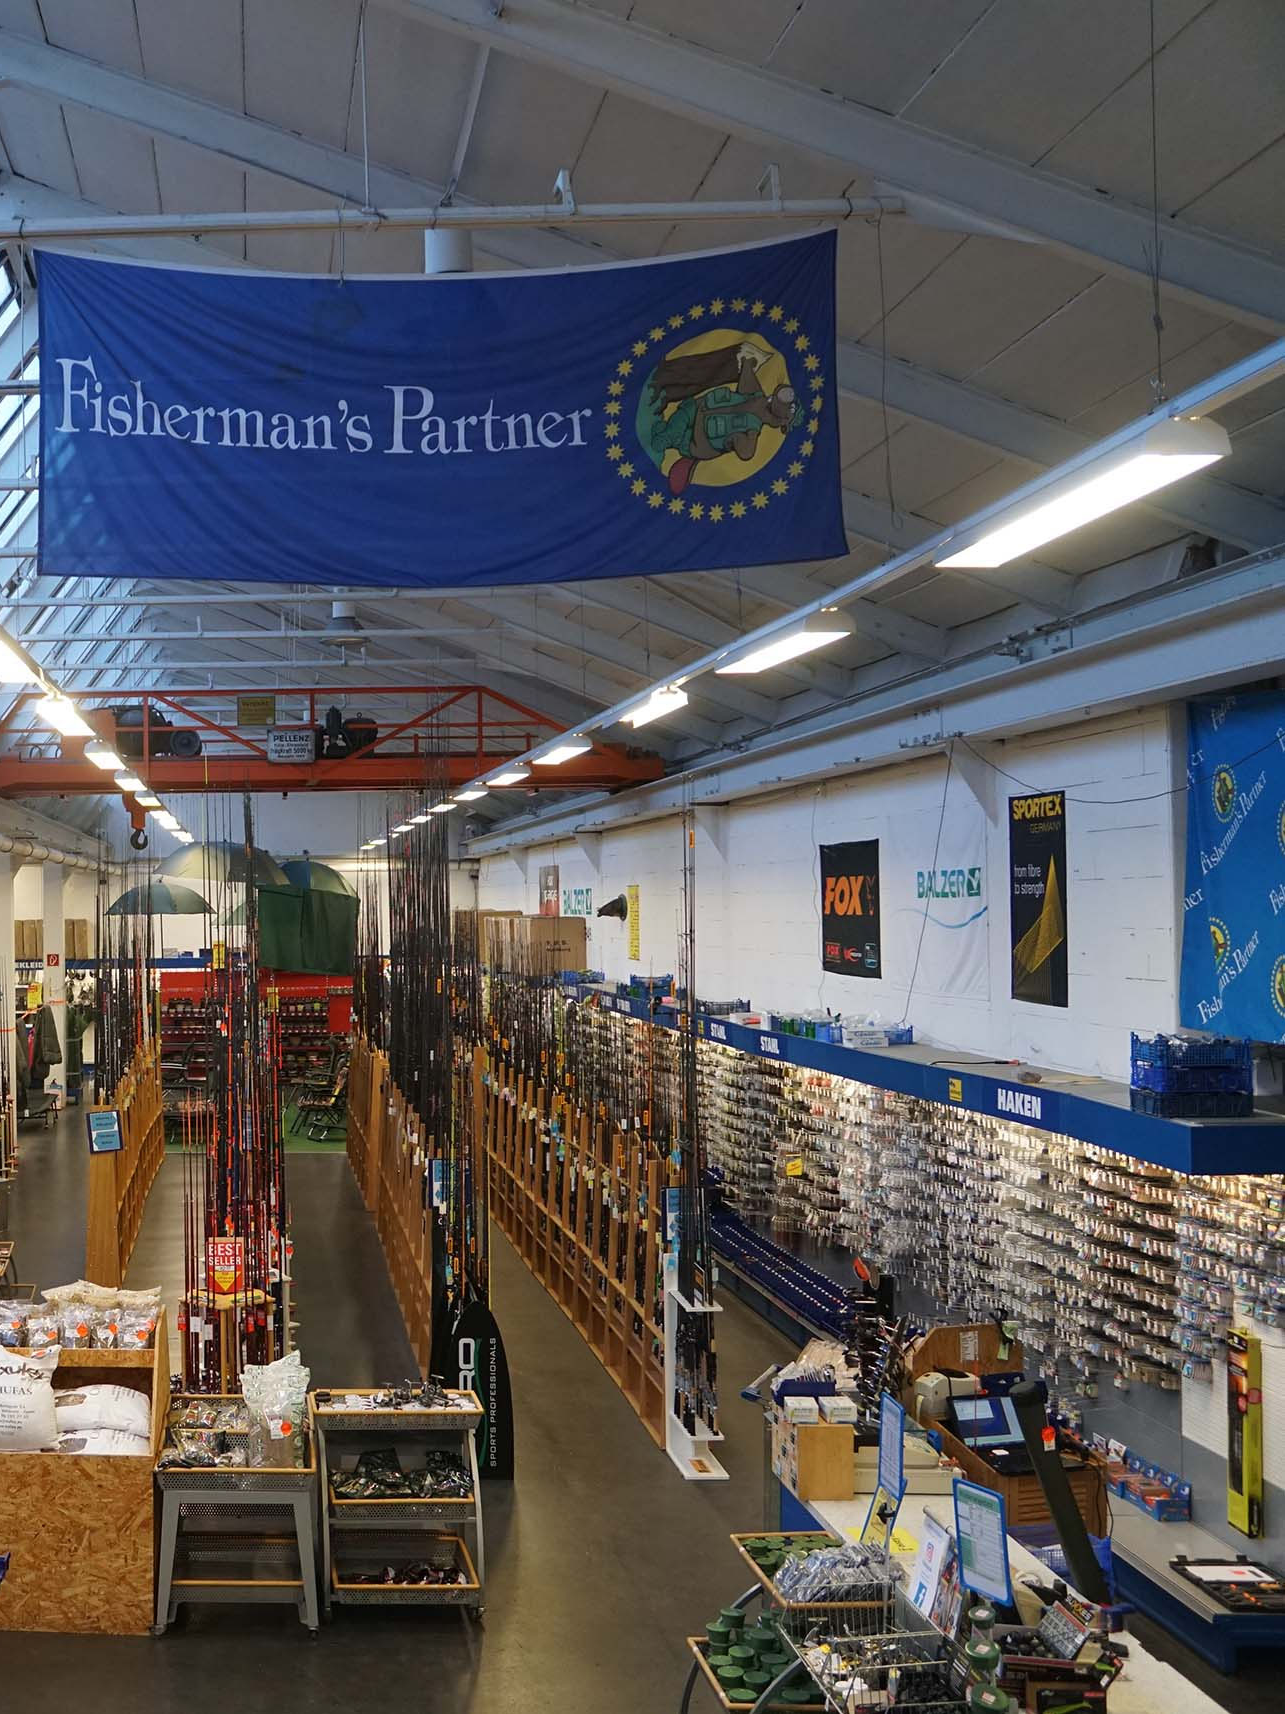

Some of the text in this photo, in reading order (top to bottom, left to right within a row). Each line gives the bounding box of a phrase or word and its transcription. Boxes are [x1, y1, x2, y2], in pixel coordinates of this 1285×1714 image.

[55, 356, 592, 455] Fisherman's Partner
[273, 734, 310, 742] PELLENZ
[1012, 794, 1062, 821] SPORTEX
[917, 869, 964, 899] BALZER
[1014, 864, 1027, 878] from
[824, 875, 864, 916] FOX
[760, 1035, 780, 1055] STAHL
[997, 1088, 1042, 1120] HAKEN
[208, 1243, 242, 1256] BEST
[208, 1256, 242, 1266] SELLER
[489, 1337, 497, 1467] SPORTS PROFESSIONALS
